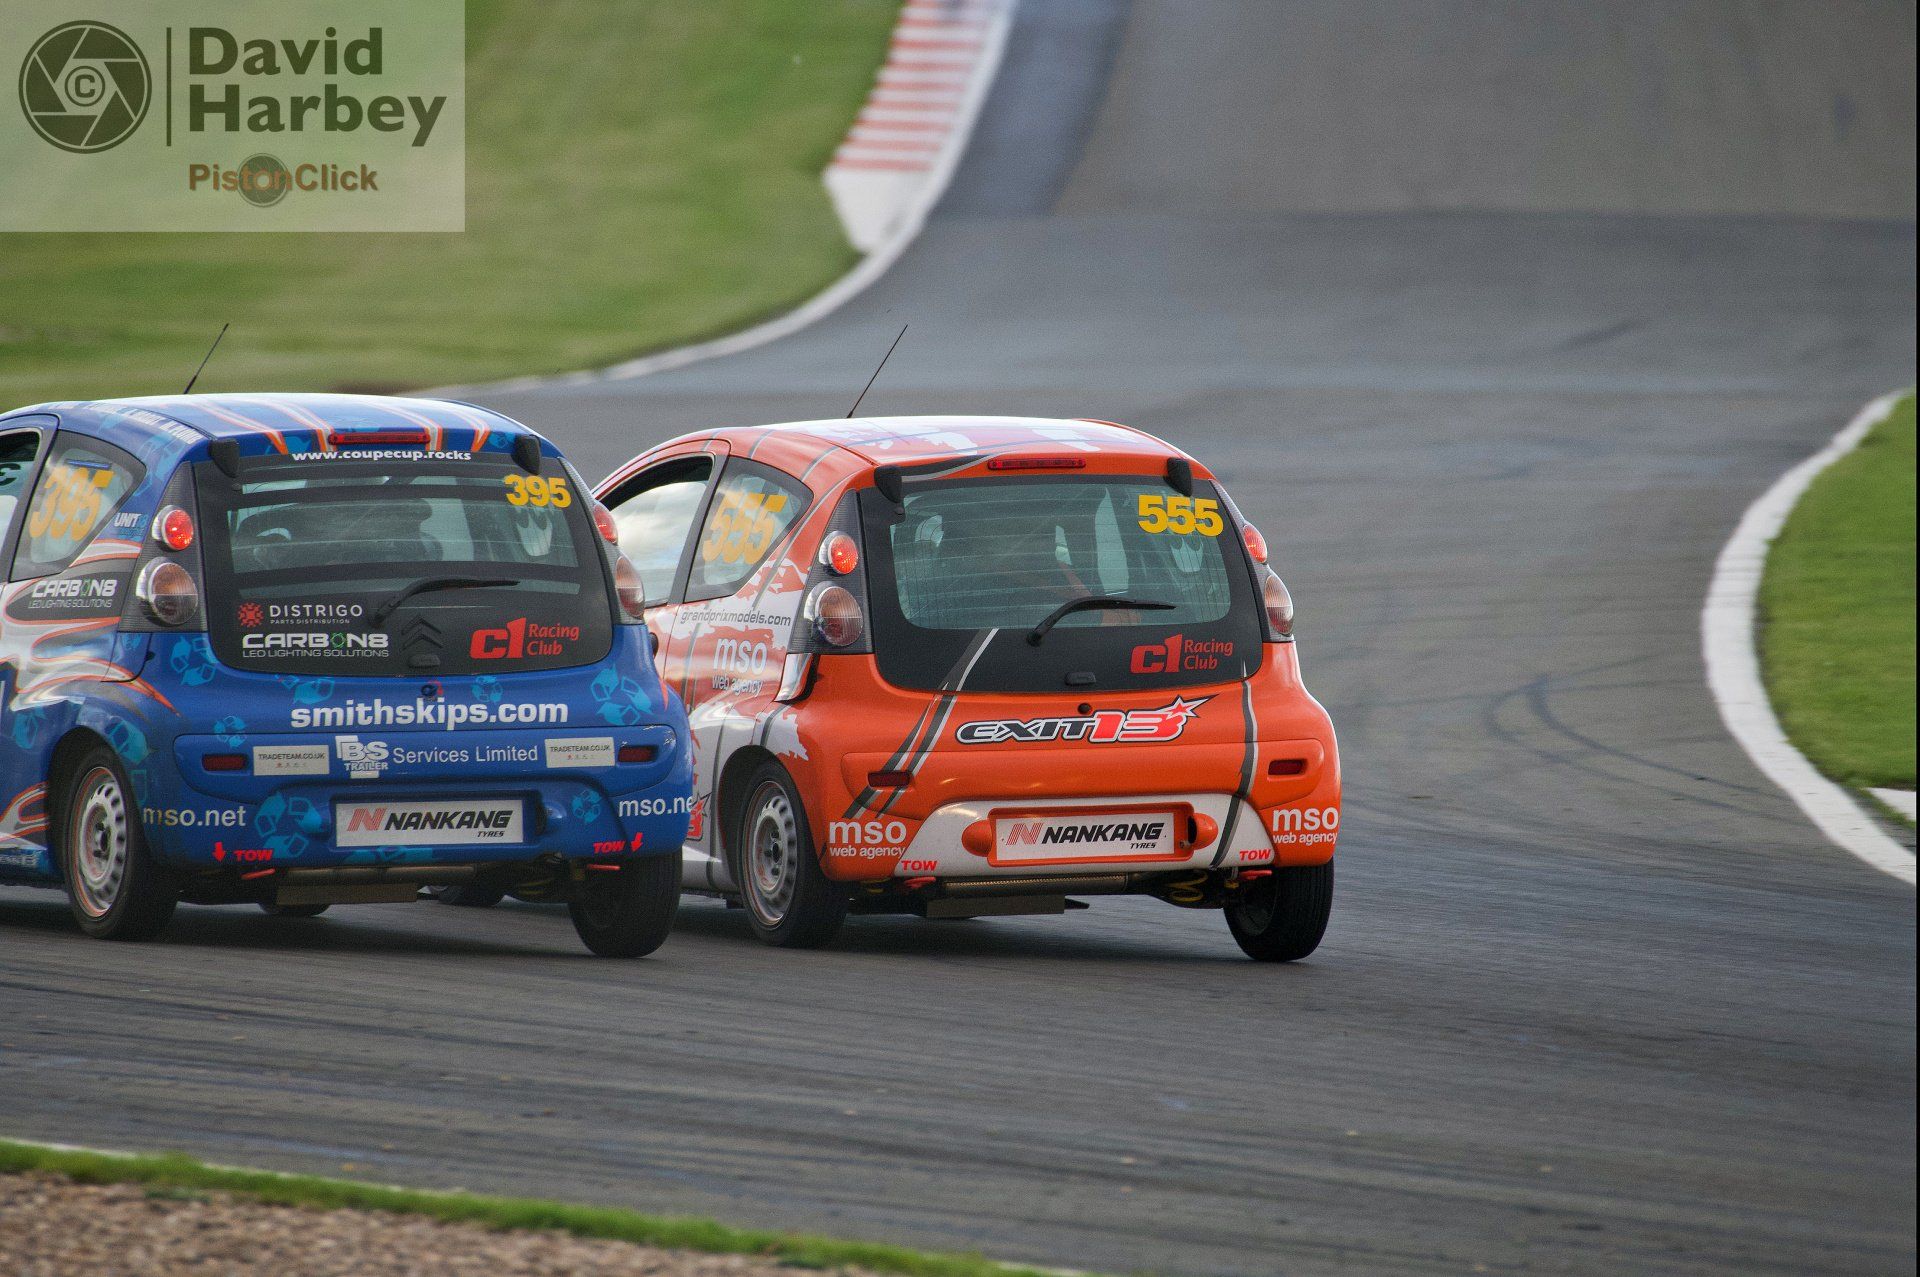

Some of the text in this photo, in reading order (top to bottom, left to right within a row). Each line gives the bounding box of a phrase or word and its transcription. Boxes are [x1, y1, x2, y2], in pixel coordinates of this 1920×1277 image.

[292, 450, 472, 462] www.coupecup.rocks
[504, 474, 571, 509] 395
[30, 466, 114, 541] 395
[1138, 494, 1224, 537] 555
[702, 490, 787, 565] 555
[269, 604, 363, 617] DISTRIGO
[681, 609, 792, 626] grandprixmodels.com
[529, 623, 580, 641] Racing
[243, 649, 390, 658] LED LIGHTING SOLUTIONS
[527, 640, 563, 655] Club
[713, 637, 767, 675] mso
[1184, 639, 1234, 656] Racing
[1184, 655, 1218, 671] Club
[712, 675, 764, 698] web agency
[291, 697, 568, 731] smithskips.com
[258, 752, 326, 761] TRADETEAM.CO.UK
[393, 745, 469, 765] Services
[475, 745, 538, 762] Limited
[344, 762, 389, 772] TRAILER
[618, 796, 693, 818] mso.ne
[142, 805, 247, 827] mso.net
[384, 810, 513, 831] NANKANG
[1272, 807, 1339, 832] mso
[477, 830, 505, 838] TYRES
[828, 820, 907, 844] mso
[1041, 822, 1165, 844] NANKANG
[1272, 832, 1338, 846] web agency
[594, 840, 627, 854] TOW
[829, 845, 908, 860] web agency
[1130, 841, 1156, 849] TYRES
[233, 848, 273, 862] TOW
[1239, 849, 1272, 861] TOW
[901, 860, 937, 871] TOW
